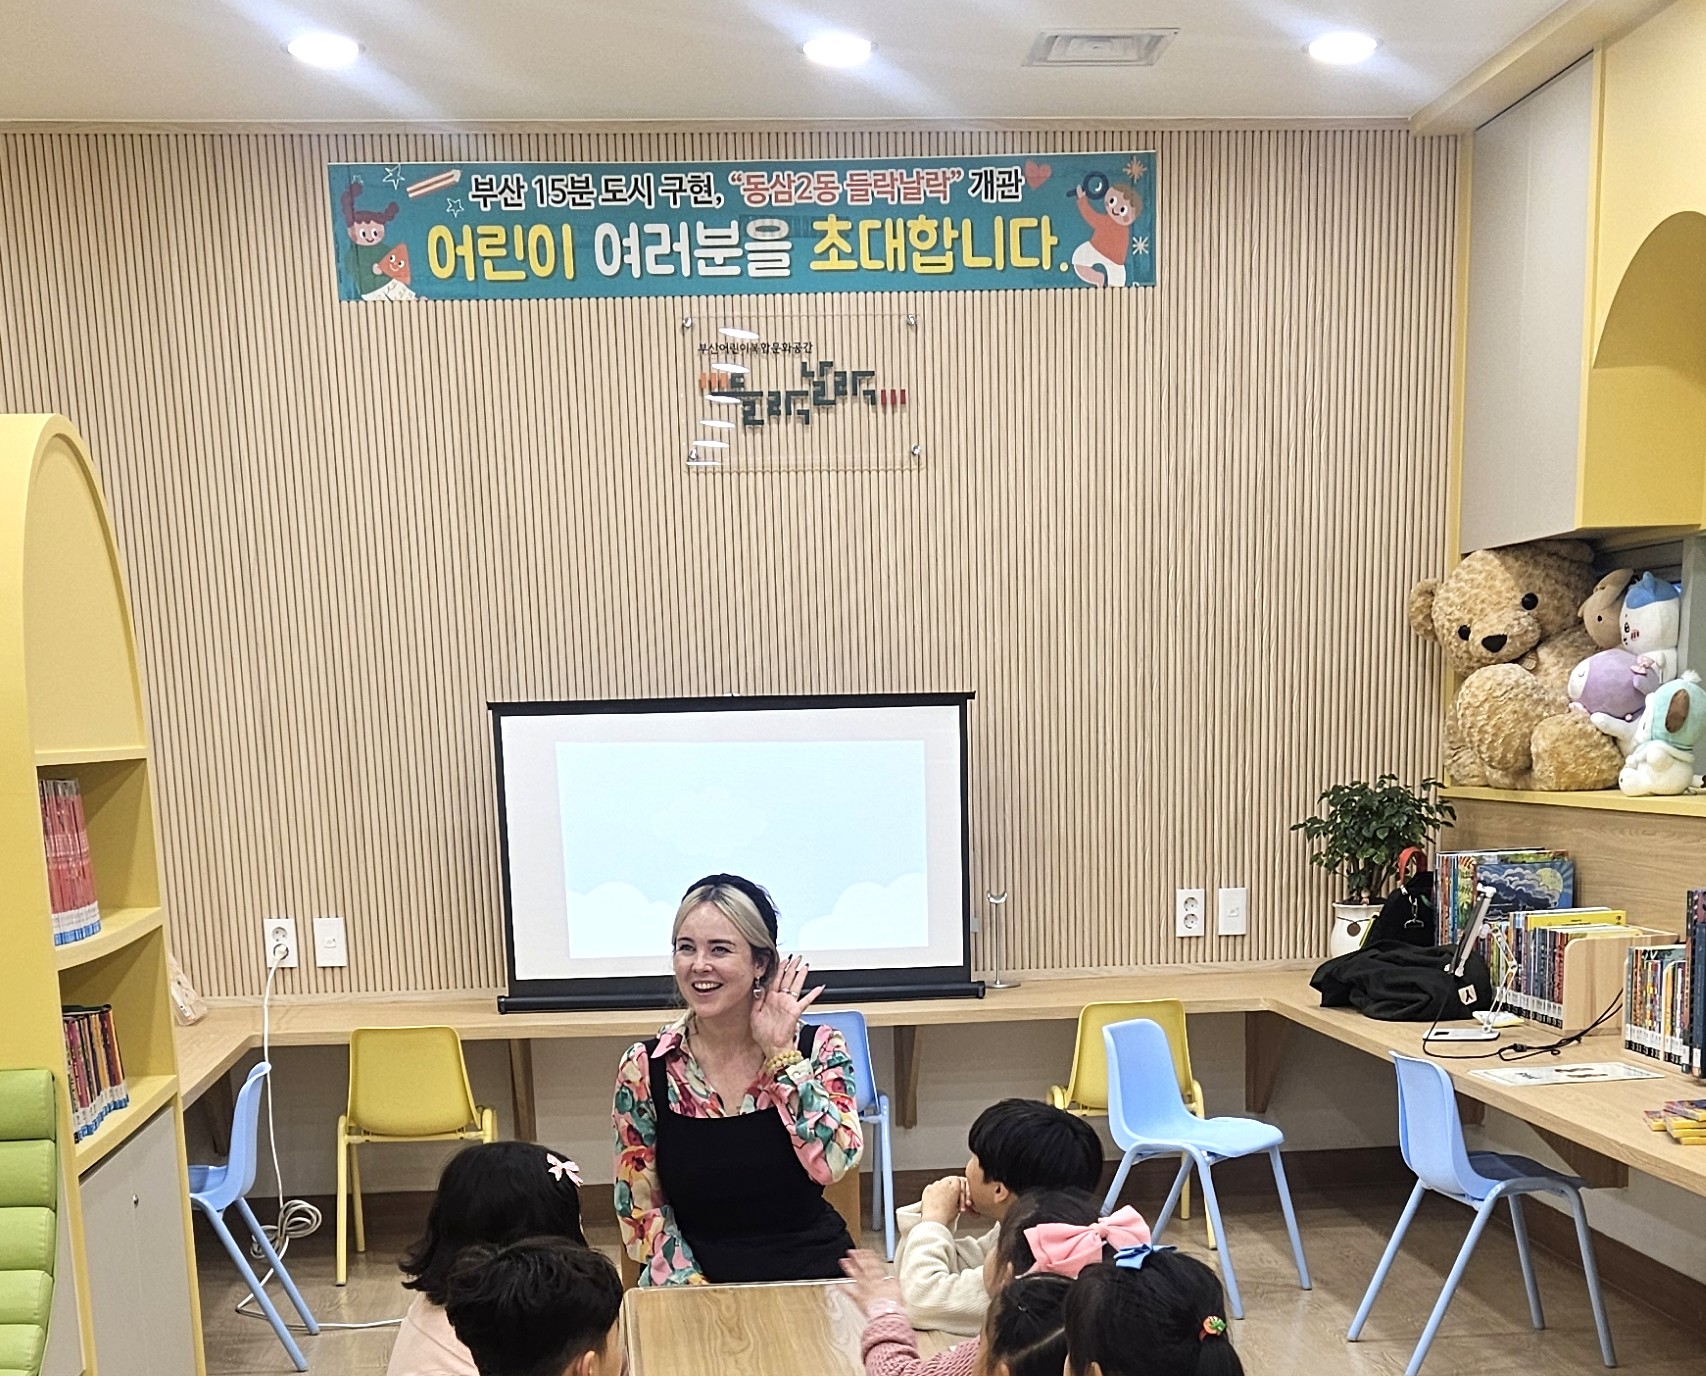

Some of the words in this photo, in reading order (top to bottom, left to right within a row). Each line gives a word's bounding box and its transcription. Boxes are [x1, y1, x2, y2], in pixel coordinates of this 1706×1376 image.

[470, 173, 527, 209] 부산
[534, 175, 596, 207] 15분
[600, 175, 655, 207] 도시
[660, 173, 723, 208] 구현,
[969, 167, 1024, 201] 개관
[427, 223, 577, 282] 어린이
[594, 217, 793, 279] 여러분을
[809, 213, 1070, 274] 초대합니다.
